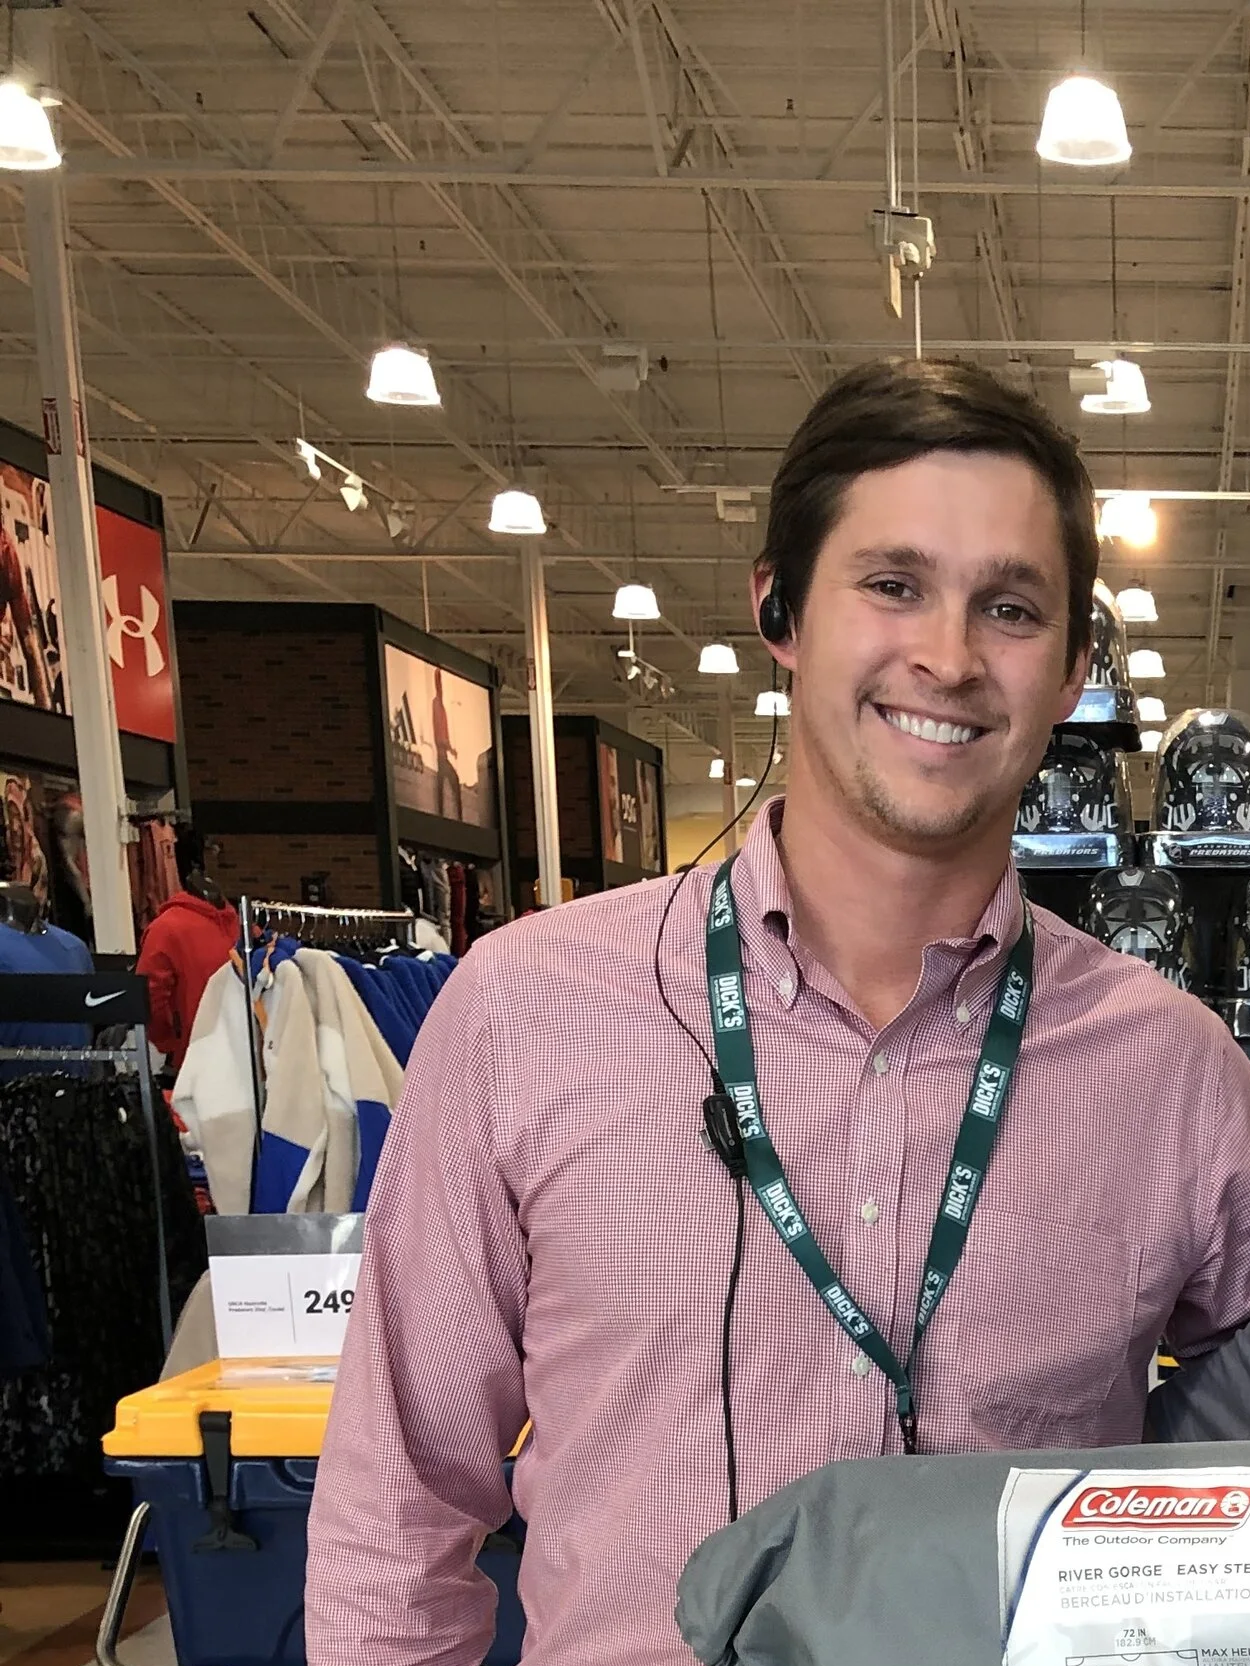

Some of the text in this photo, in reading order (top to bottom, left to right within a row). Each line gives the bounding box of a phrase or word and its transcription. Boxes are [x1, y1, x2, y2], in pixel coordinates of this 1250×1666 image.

[1033, 848, 1097, 856] PREDATORS
[719, 976, 743, 1028] DICK'S
[1000, 971, 1024, 1020] DICK'S
[972, 1064, 1001, 1116] DICK'S
[734, 1085, 760, 1139] DICK'S
[766, 1182, 803, 1237] DICK'S
[945, 1165, 973, 1219] DICK'S
[827, 1285, 869, 1335] DICK'S
[917, 1271, 940, 1326] DICK'S
[1080, 1489, 1218, 1517] Coleman
[1063, 1535, 1228, 1547] The Outdoor Company
[1058, 1568, 1103, 1582] RIVER
[1108, 1564, 1162, 1579] GORGE
[1177, 1564, 1218, 1575] EASY
[1061, 1592, 1131, 1609] BERCEAU
[1116, 1637, 1157, 1648] 182.9 CM
[1123, 1628, 1147, 1638] 72 IN
[1201, 1648, 1228, 1657] MAX
